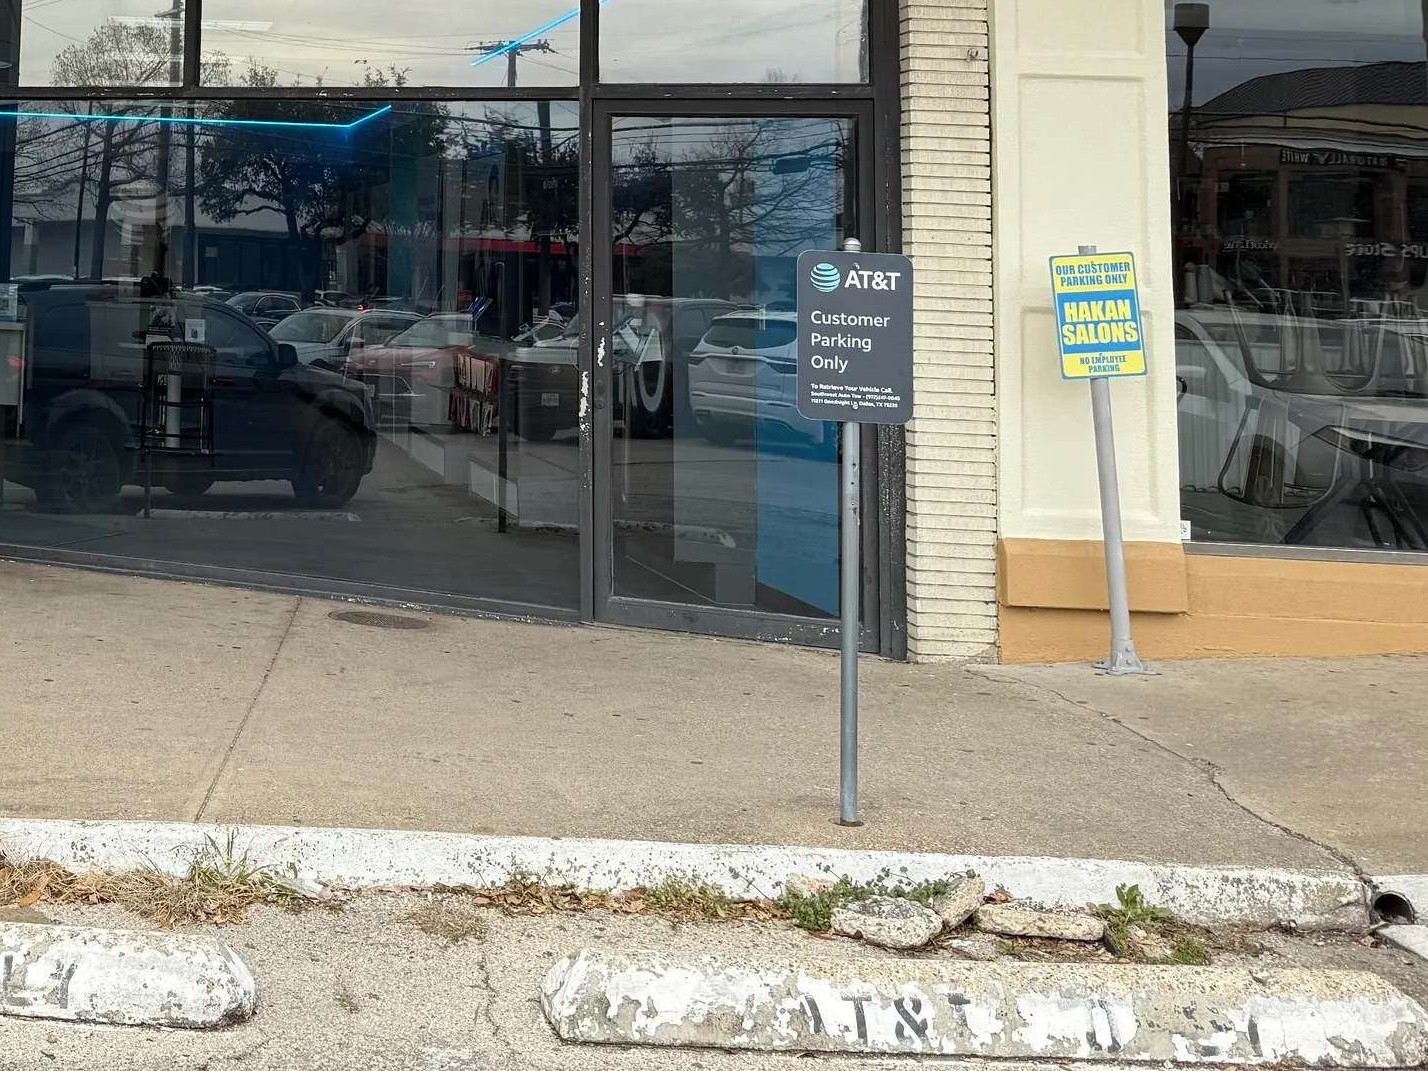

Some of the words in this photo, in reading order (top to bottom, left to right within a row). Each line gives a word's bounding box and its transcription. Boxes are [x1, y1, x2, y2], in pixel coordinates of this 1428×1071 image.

[1055, 265, 1076, 276] OUR
[1077, 261, 1131, 275] CUSTOMER
[844, 270, 901, 291] AT&T
[1060, 274, 1103, 287] PARKING
[1105, 273, 1128, 285] ONLY
[810, 311, 891, 328] Customer
[1063, 299, 1132, 323] HAKAN
[1062, 321, 1139, 346] SALONS
[811, 333, 872, 352] Parking
[811, 355, 849, 373] Only
[1080, 356, 1090, 365] NO
[1091, 355, 1127, 365] EMPLOYEE
[1088, 364, 1120, 373] PARKING
[819, 383, 844, 391] Retrieve
